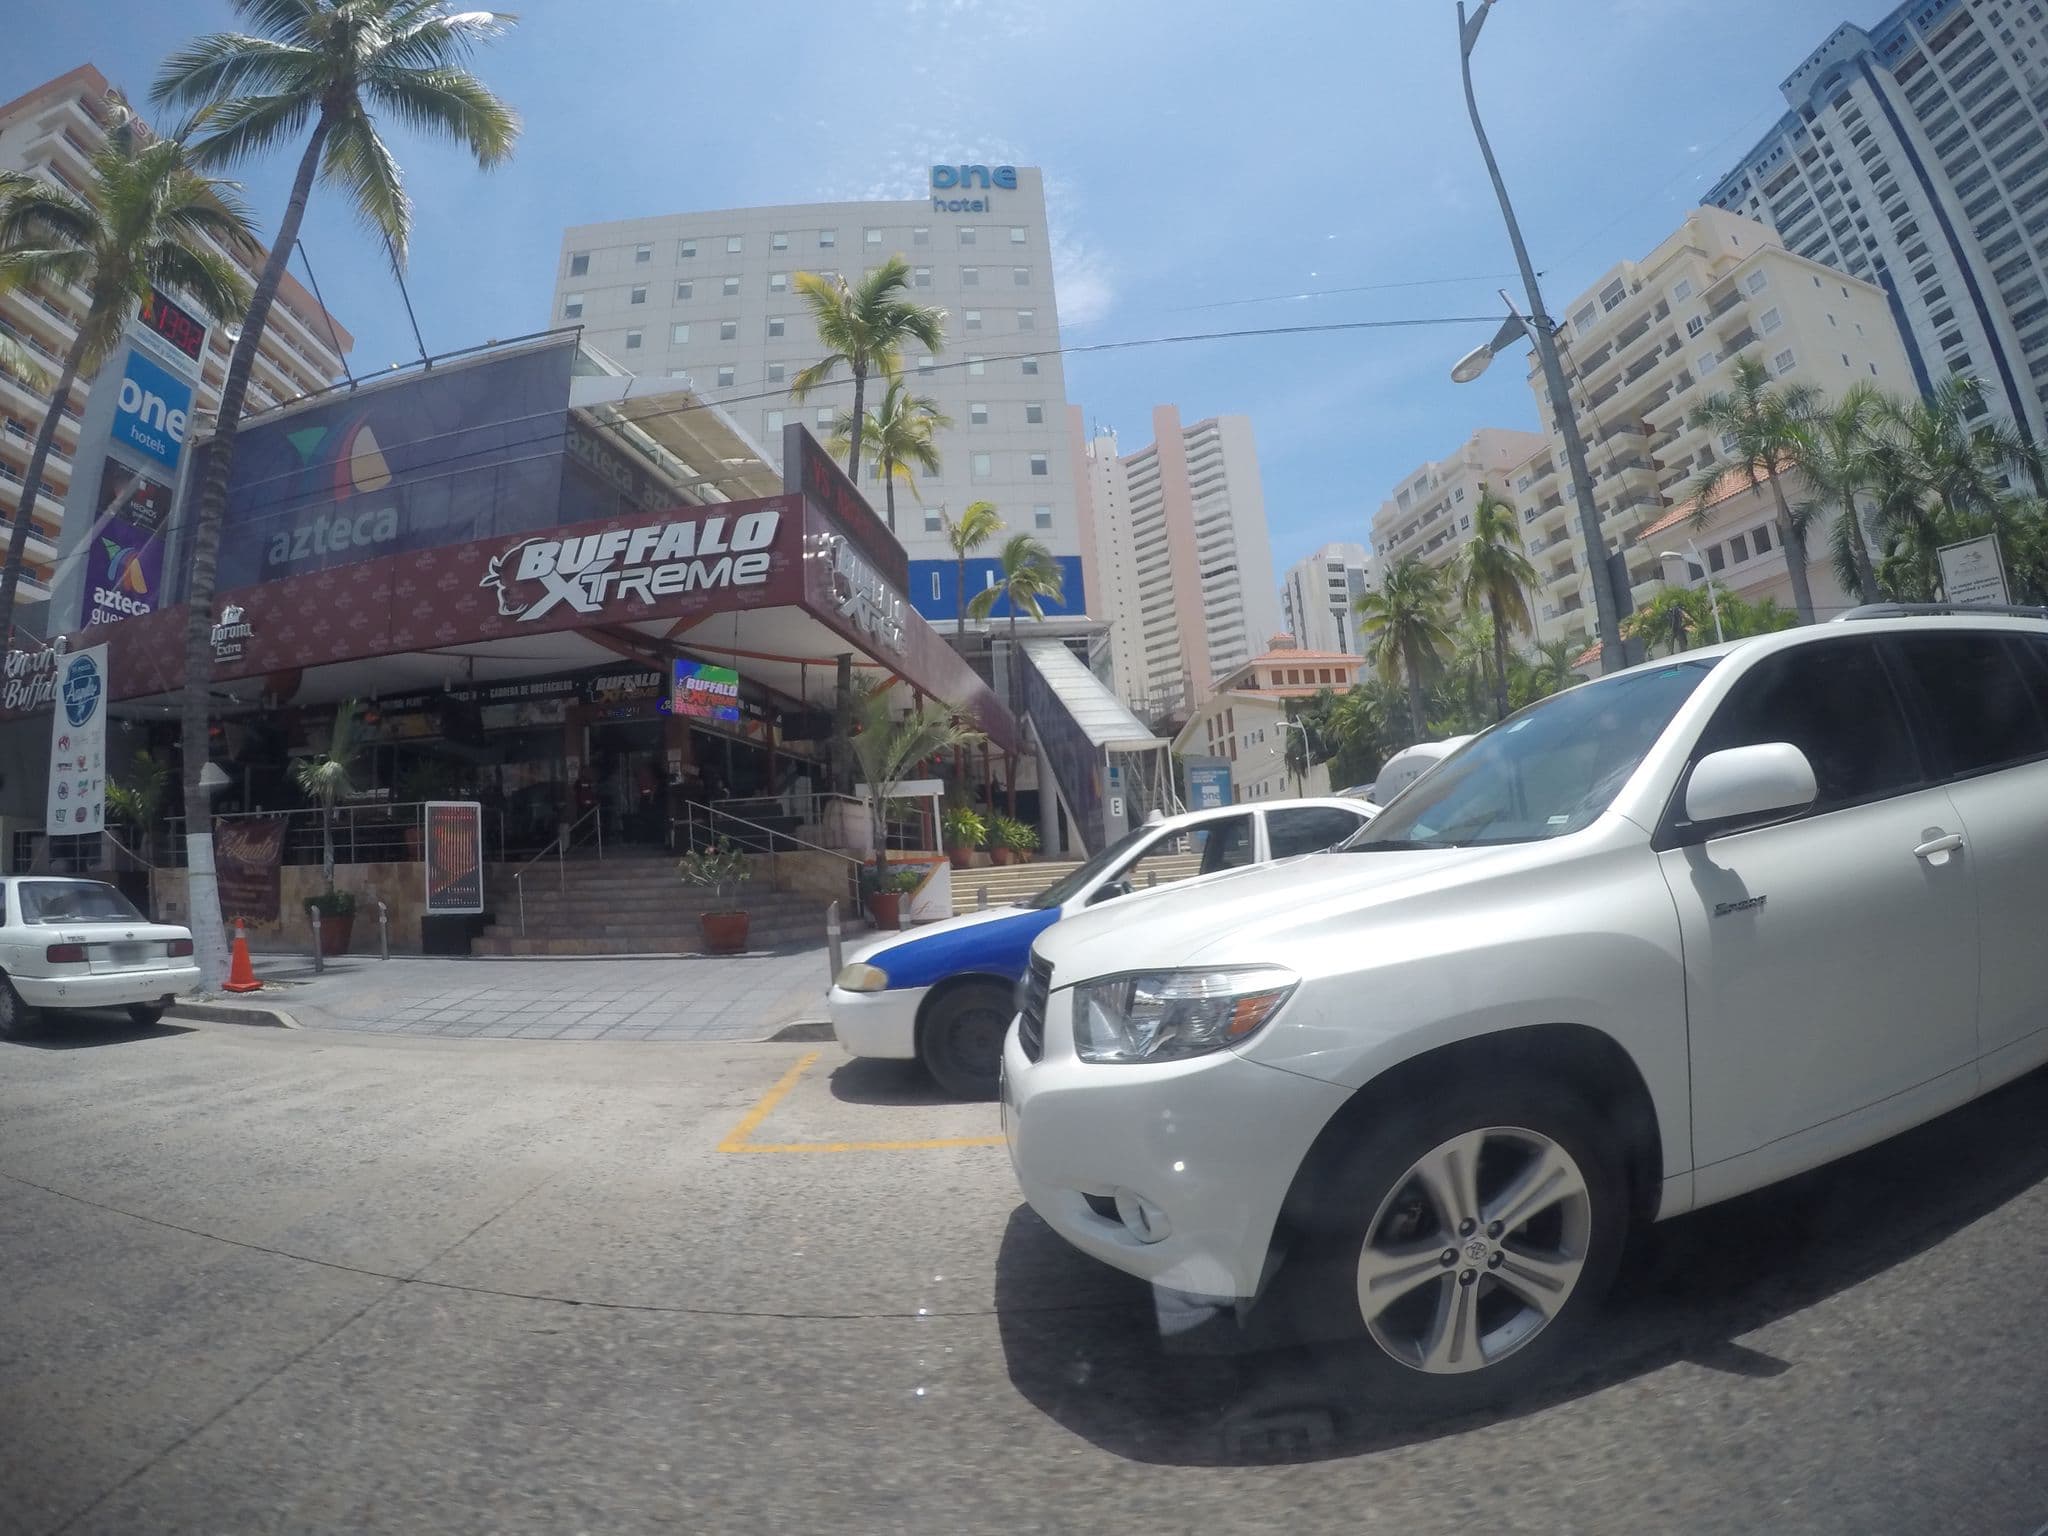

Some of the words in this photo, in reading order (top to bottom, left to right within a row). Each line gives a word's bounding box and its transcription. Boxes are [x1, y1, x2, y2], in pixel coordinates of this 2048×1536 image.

[933, 165, 1017, 190] one
[933, 195, 990, 213] hotel
[118, 378, 187, 444] one
[130, 424, 166, 455] hotels
[269, 507, 398, 566] azteca
[516, 511, 779, 581] BUFFALO
[93, 586, 151, 617] azteca
[211, 623, 255, 647] Corona
[217, 642, 241, 656] Extra
[596, 672, 661, 691] BUFFALO
[686, 677, 738, 697] BUFFALO
[1113, 800, 1121, 815] E
